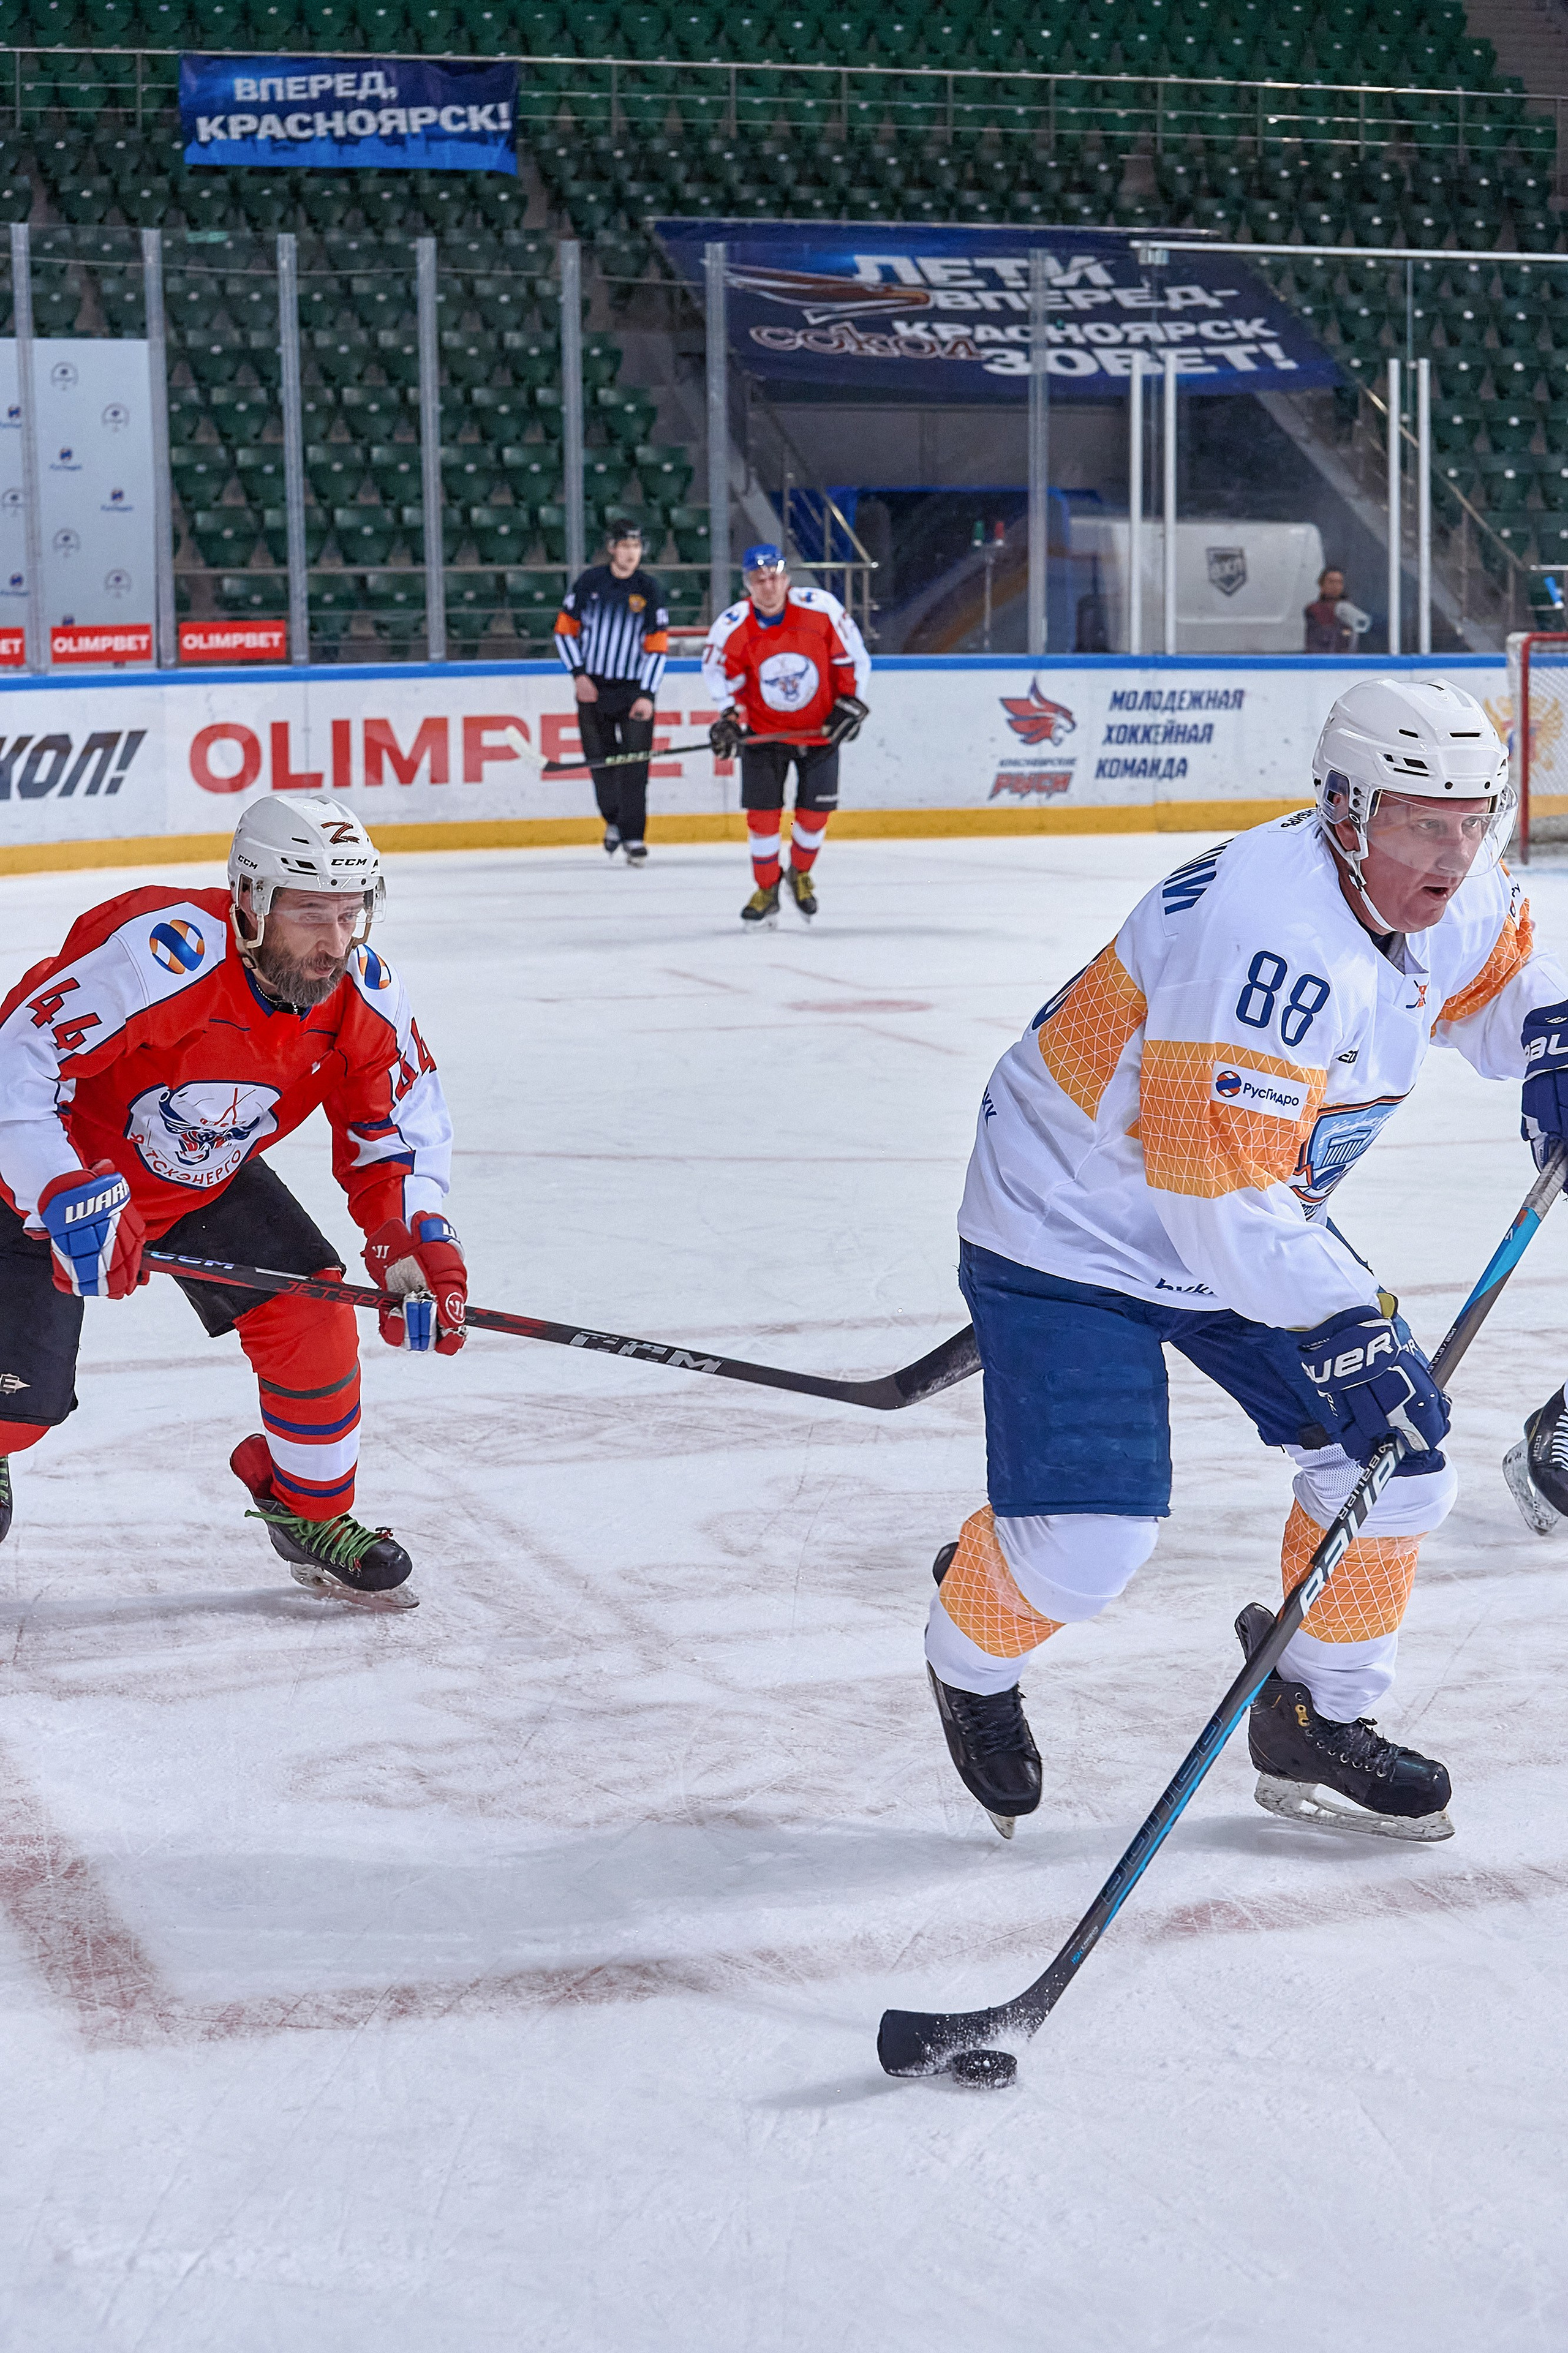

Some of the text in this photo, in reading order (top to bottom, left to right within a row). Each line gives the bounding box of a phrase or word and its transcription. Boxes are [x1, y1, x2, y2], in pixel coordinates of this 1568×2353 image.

[234, 70, 398, 102] ВПЕРЕД,
[195, 102, 513, 143] КРАСНОЯРСК!
[854, 255, 1114, 288] ЛЕТИ
[892, 318, 1280, 344] КРАСНОЯРСК
[982, 342, 1299, 377] ЗОВЕТ!
[53, 633, 150, 653] OLIMPBET
[182, 631, 283, 650] OLIMPBET
[1109, 688, 1245, 713] МОЛОДЕЖНАЯ
[1102, 720, 1214, 746] ХОККЕЙНАЯ
[1095, 756, 1187, 781] КОМАНДА
[237, 854, 258, 870] CCM
[331, 858, 368, 867] CCM
[1235, 950, 1330, 1047] 88
[25, 977, 103, 1050] 44
[1243, 1083, 1299, 1107] РусГидро
[150, 1251, 235, 1270] CCM
[569, 1330, 725, 1374] CCM
